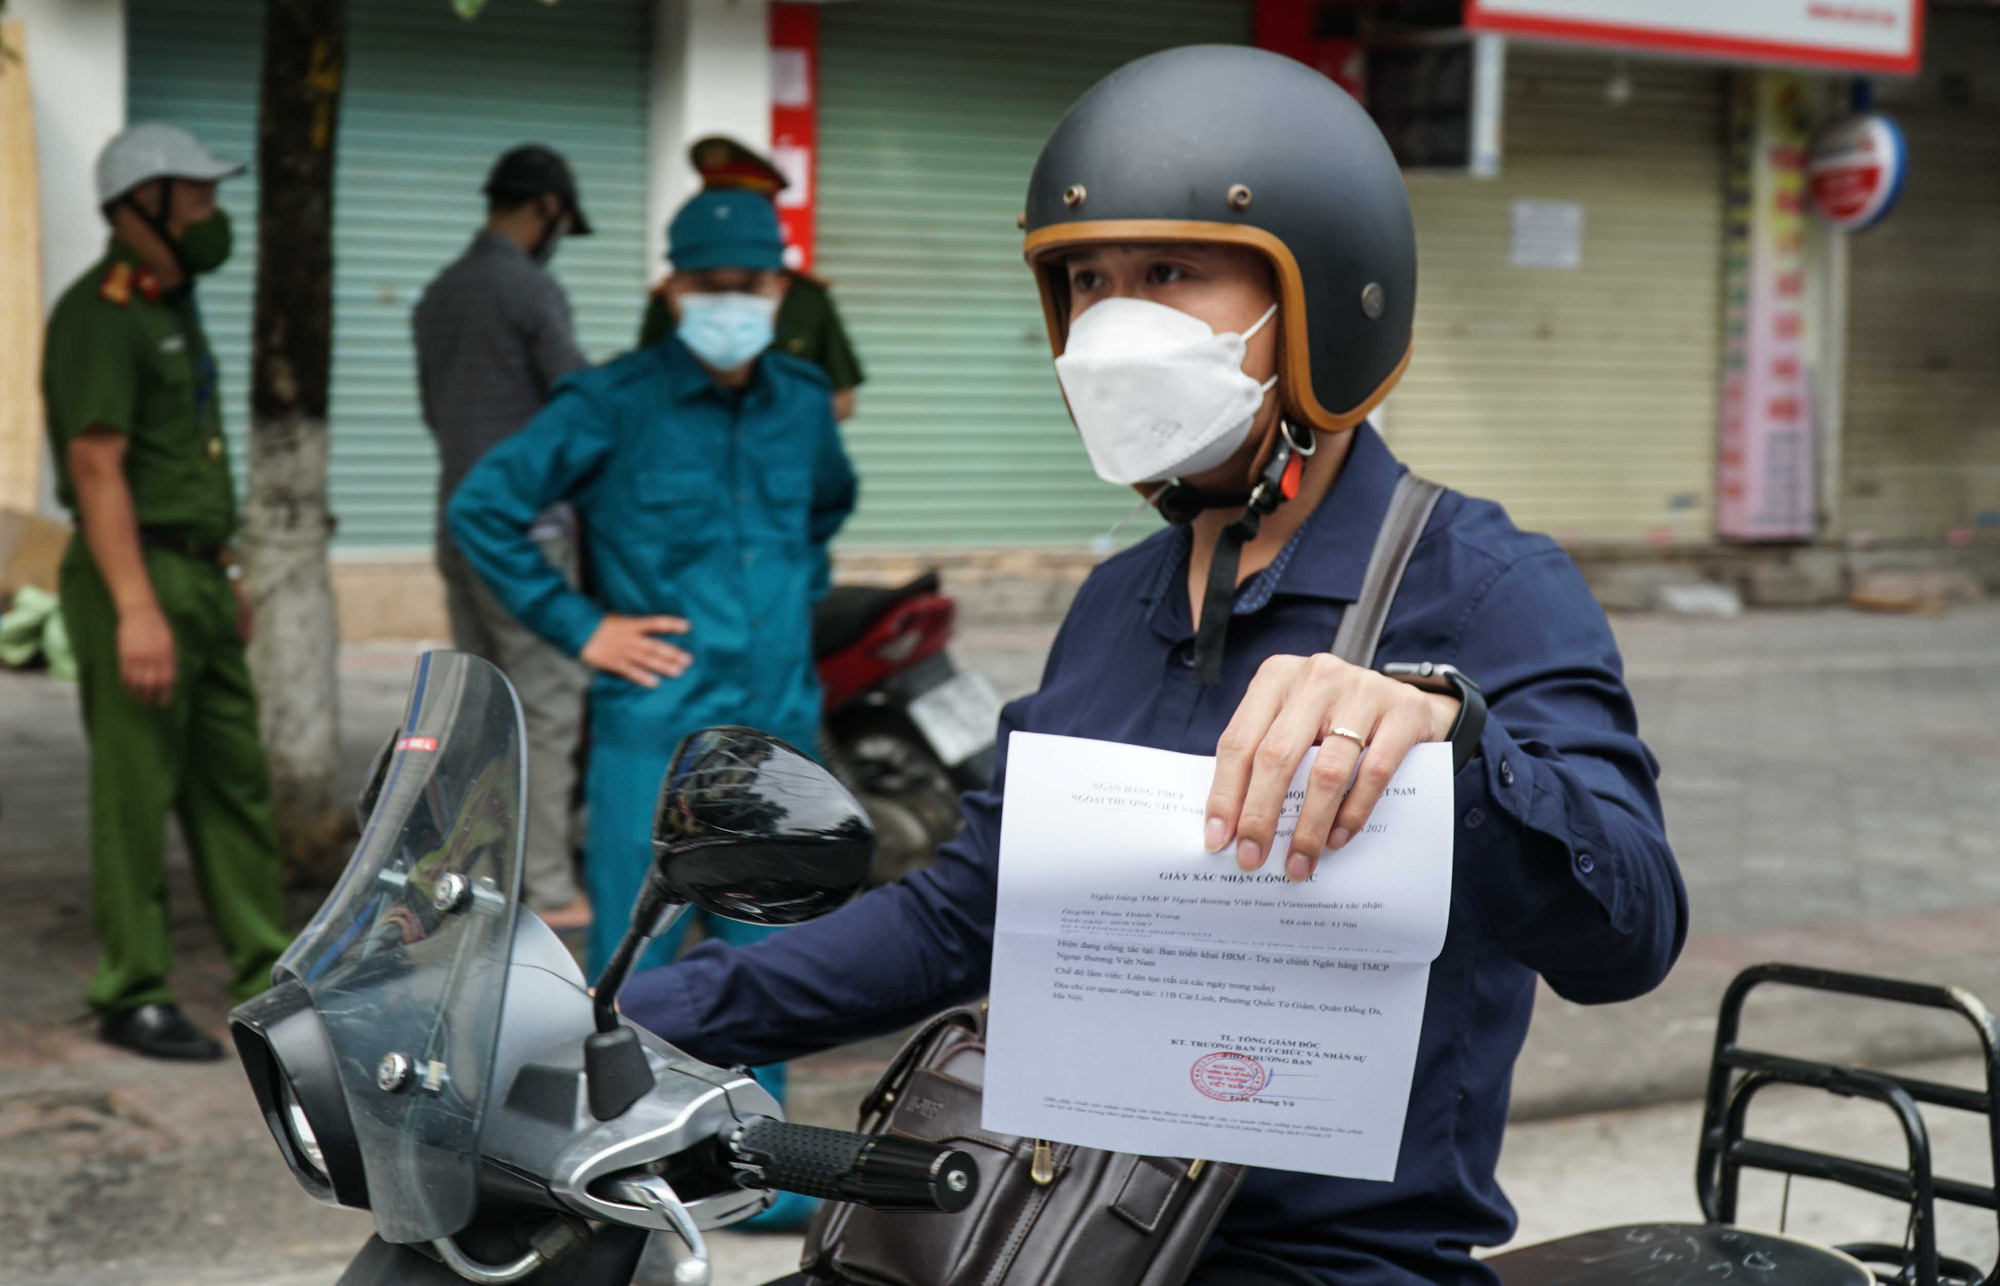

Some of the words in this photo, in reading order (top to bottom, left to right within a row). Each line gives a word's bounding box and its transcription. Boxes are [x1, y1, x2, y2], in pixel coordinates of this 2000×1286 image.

[1392, 787, 1416, 797] NAM
[1366, 824, 1388, 833] 2021
[1136, 958, 1156, 967] Nam
[1158, 947, 1176, 956] Ban
[1222, 952, 1246, 962] HRM
[1256, 954, 1271, 964] Trụ
[1286, 956, 1310, 966] chính
[1312, 958, 1335, 969] Ngân
[1338, 960, 1358, 971] hàng
[1361, 962, 1390, 972] TMCP
[1206, 979, 1226, 990] ngày
[1229, 982, 1252, 992] trong
[1253, 982, 1276, 993] tuần)
[1160, 990, 1177, 1000] 11B
[1318, 1002, 1342, 1013] Quận
[1268, 1036, 1298, 1048] GIÁM
[1170, 1038, 1188, 1046] KT.
[1235, 1044, 1256, 1053] BAN
[1274, 1045, 1302, 1057] CHỨC
[1306, 1048, 1320, 1058] VÀ
[1322, 1050, 1350, 1061] NHÂN
[1353, 1053, 1369, 1064] SỰ
[1292, 1058, 1313, 1066] BAN
